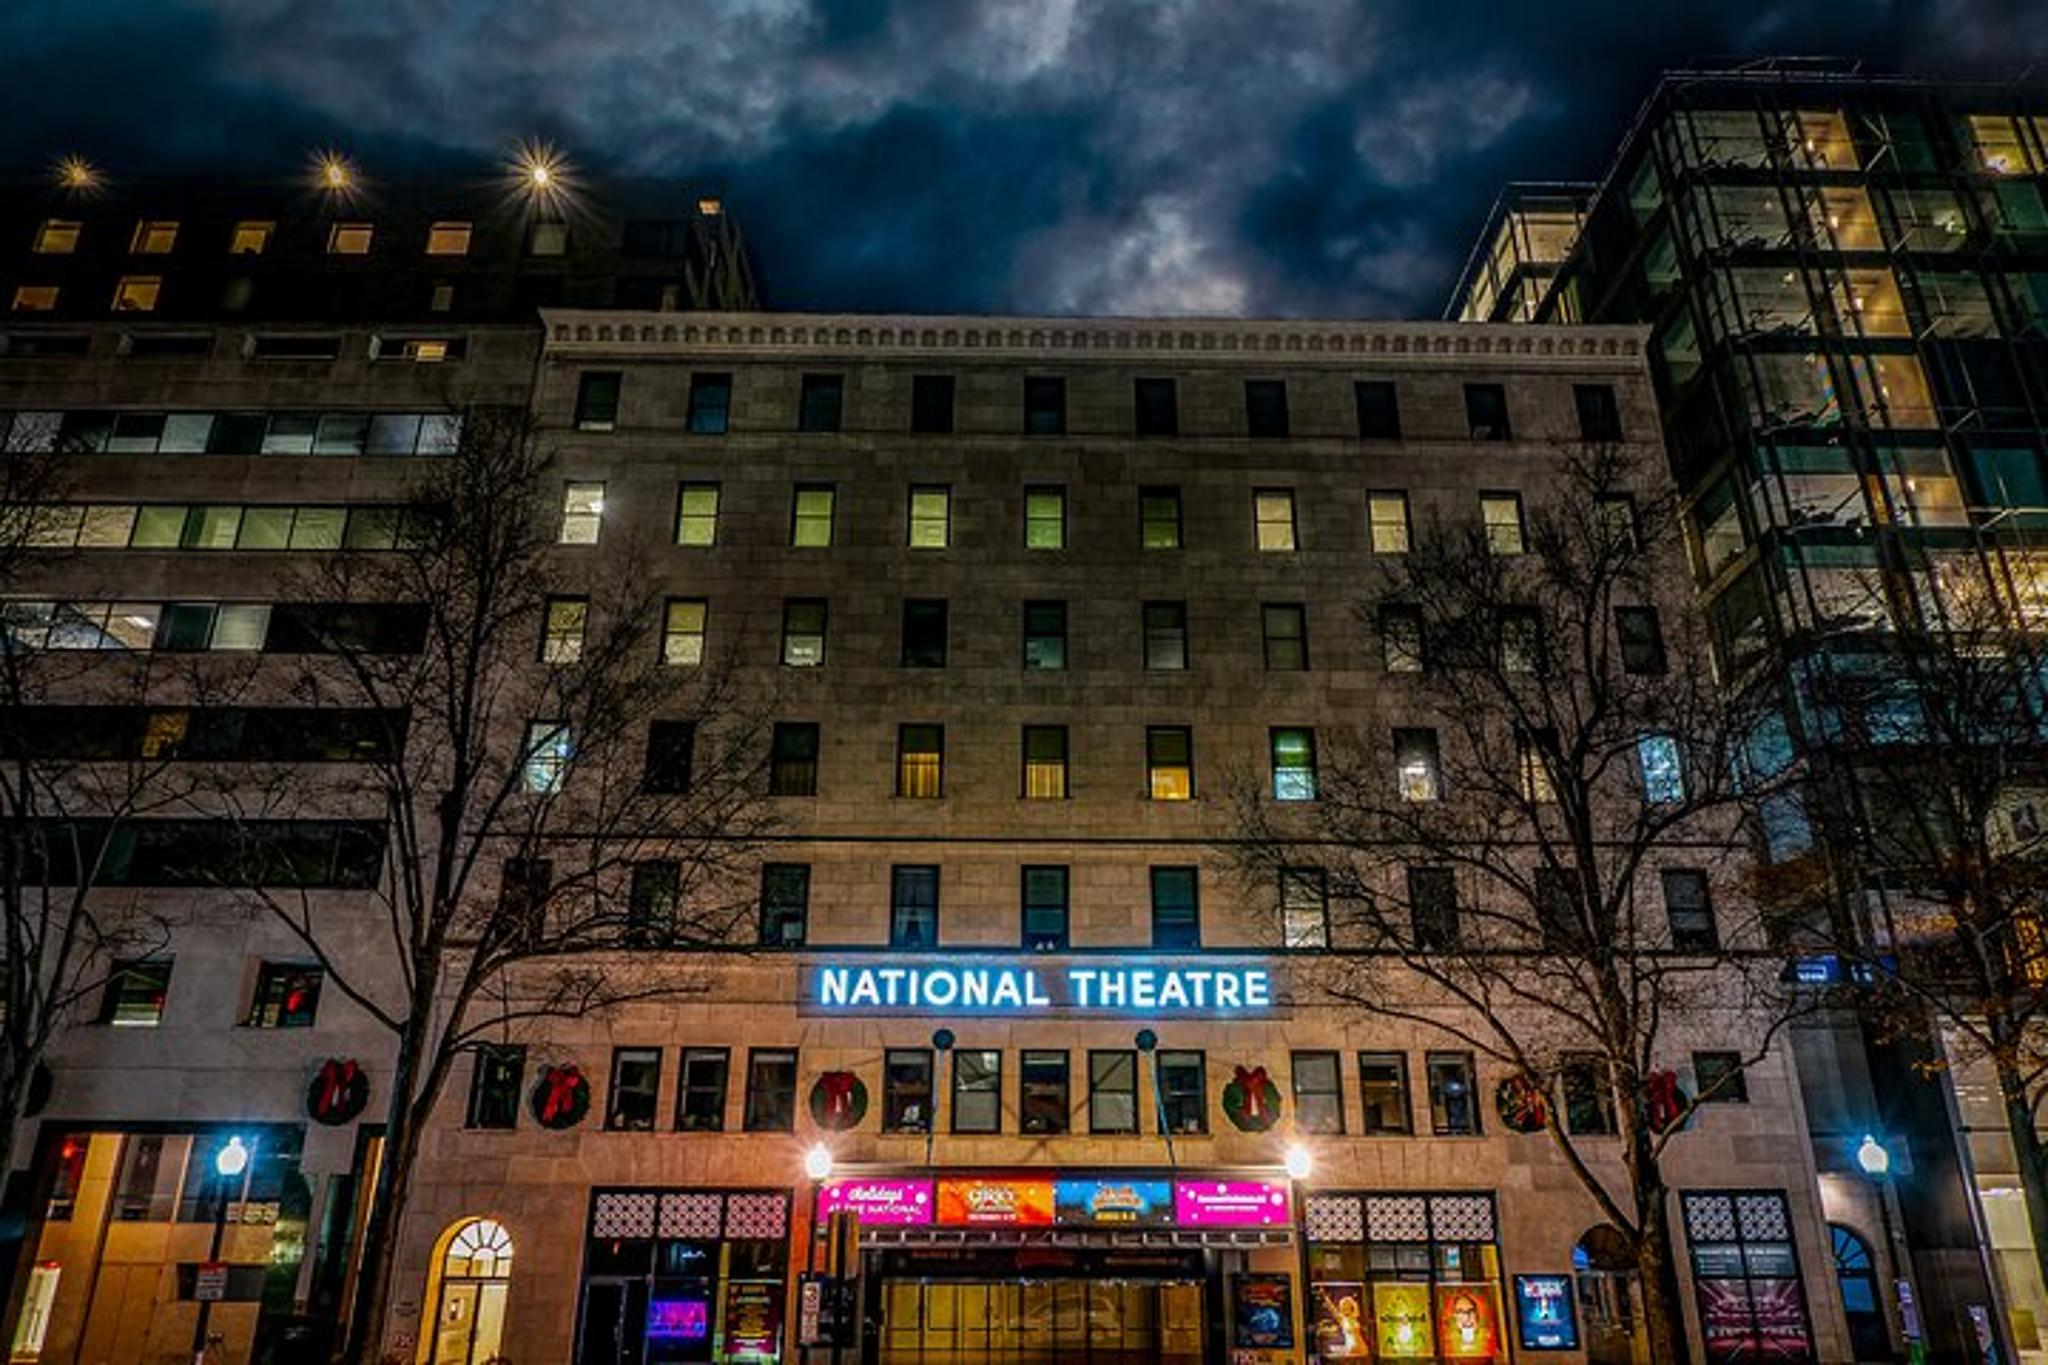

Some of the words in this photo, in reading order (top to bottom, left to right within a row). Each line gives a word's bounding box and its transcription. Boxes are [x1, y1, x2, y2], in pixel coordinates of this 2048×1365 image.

[820, 968, 1050, 1008] NATIONAL
[1069, 969, 1271, 1009] THEATRE
[843, 1204, 864, 1215] THE
[867, 1204, 922, 1215] NATIONAL
